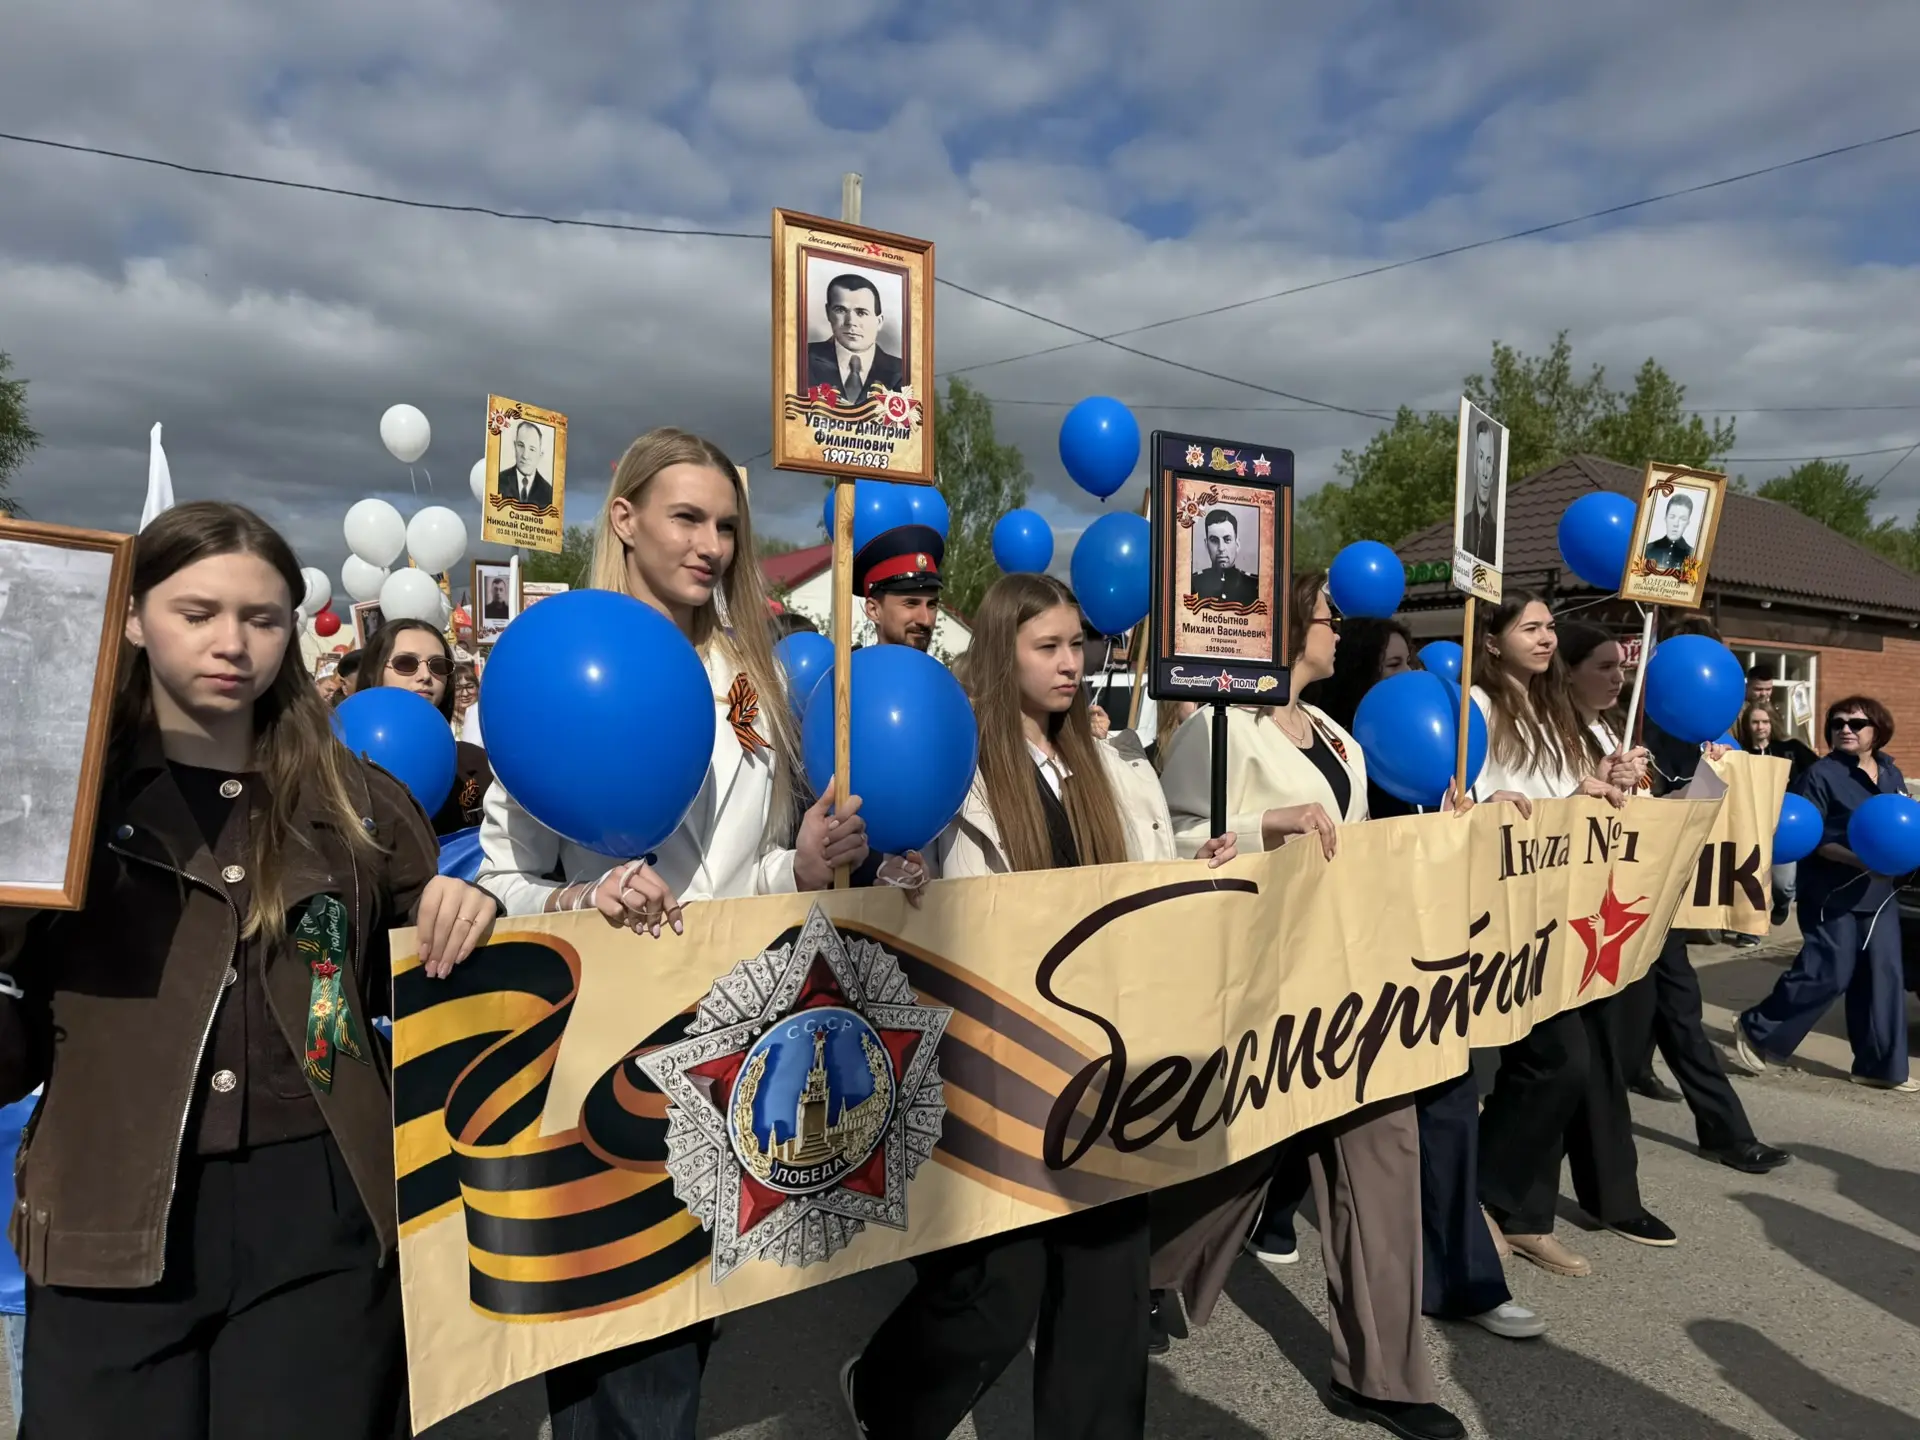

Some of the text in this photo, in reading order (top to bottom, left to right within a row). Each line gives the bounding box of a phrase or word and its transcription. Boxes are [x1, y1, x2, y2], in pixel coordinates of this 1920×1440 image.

[805, 412, 911, 440] Уваров Дмитрий
[814, 429, 894, 453] Филиппович
[822, 448, 889, 469] 1907-1943
[487, 516, 558, 536] Николай Сергеевич
[509, 511, 543, 525] Сазанов
[1202, 612, 1249, 626] Несбытнов
[1182, 622, 1267, 639] Михаил Васильевич
[1583, 816, 1639, 864] №1
[787, 1016, 853, 1039] СССР
[775, 1158, 847, 1184] ПОБЕДА
